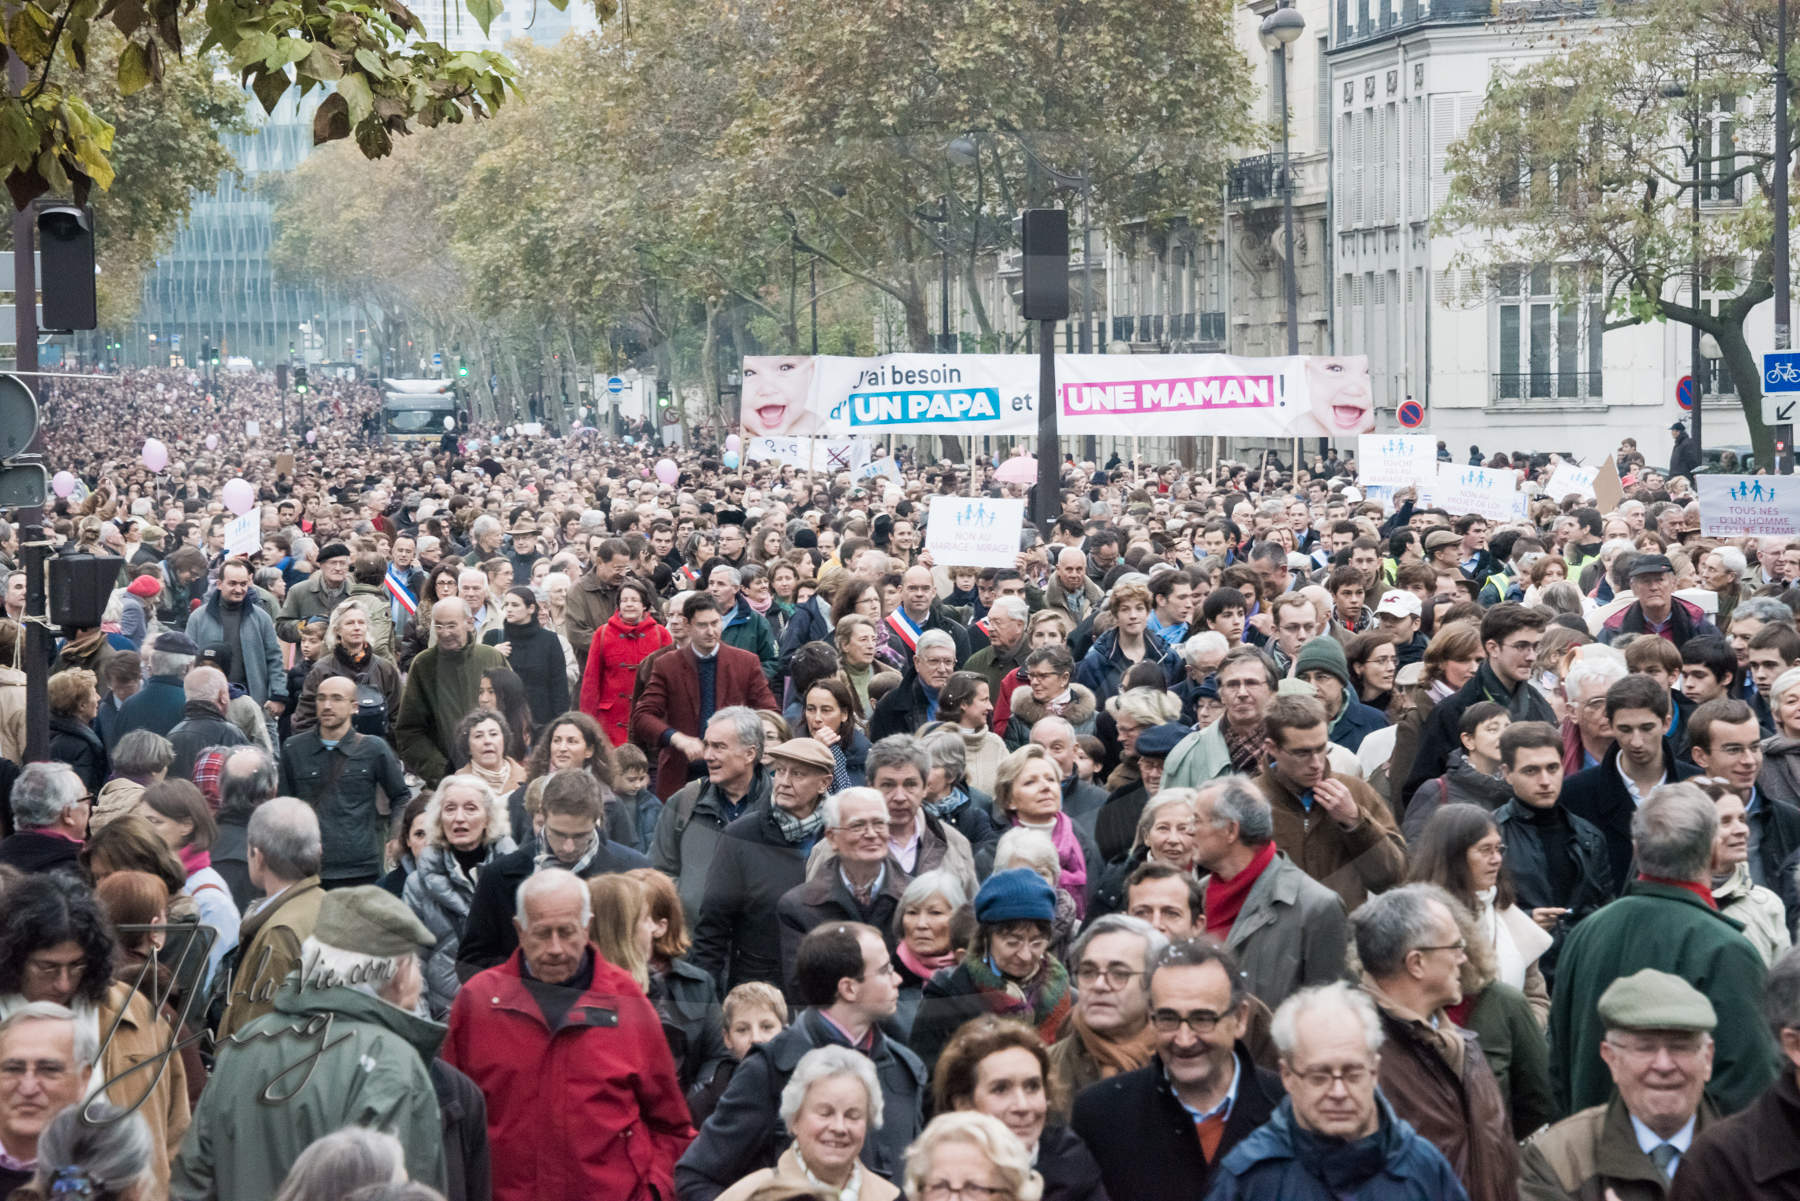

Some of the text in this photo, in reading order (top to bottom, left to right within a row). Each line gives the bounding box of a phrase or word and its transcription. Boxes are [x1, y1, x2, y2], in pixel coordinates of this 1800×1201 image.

[853, 363, 961, 389] J'ai besoin
[829, 395, 902, 422] d'UN
[907, 391, 996, 420] PAPA
[1011, 394, 1033, 412] et
[1141, 379, 1270, 409] MAMAN
[1729, 506, 1756, 515] TOUS
[1720, 516, 1790, 525] D'UN HOMME
[1709, 525, 1720, 534] ET
[1760, 526, 1796, 534] FEMME
[955, 530, 992, 541] NON AU
[930, 540, 969, 552] MARIAGE
[976, 543, 1009, 553] MIRAGE
